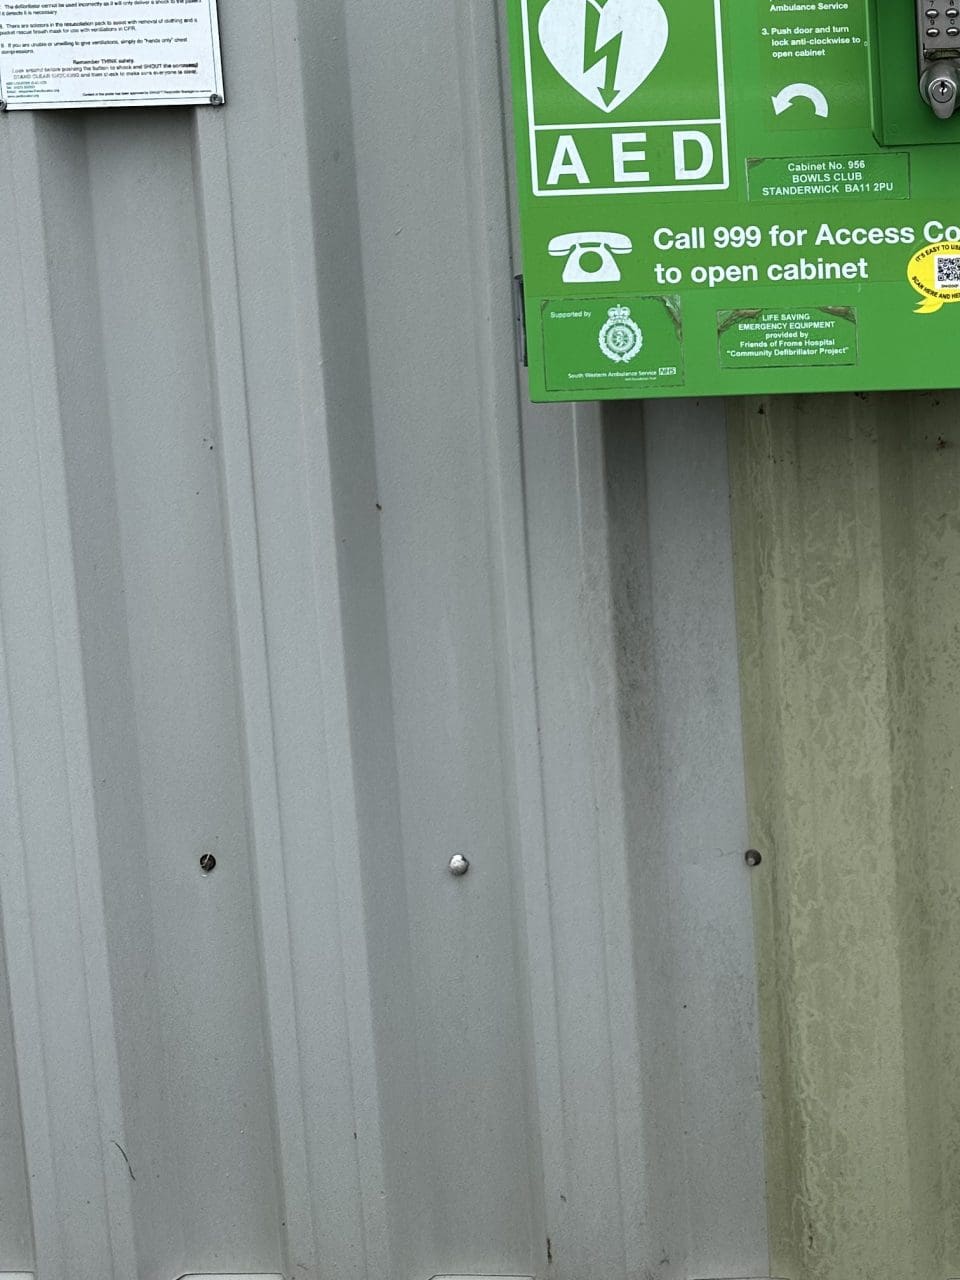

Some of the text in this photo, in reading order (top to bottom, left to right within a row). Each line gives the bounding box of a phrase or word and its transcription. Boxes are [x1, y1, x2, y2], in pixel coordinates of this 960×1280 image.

[770, 1, 849, 12] Ambulance Service
[761, 28, 770, 36] 3.
[771, 27, 792, 36] Push
[793, 26, 813, 35] door
[815, 25, 831, 34] and
[771, 36, 861, 47] lock anti-clockwise to
[772, 49, 826, 59] open cabinet
[787, 160, 866, 172] Cabinet No. 956
[792, 172, 862, 184] BOWLS CLUB
[762, 182, 894, 196] STANDERWICK BA11 2PU
[653, 226, 705, 250] Call
[713, 225, 762, 248] 999
[768, 224, 808, 247] for
[814, 223, 915, 246] Access
[915, 253, 926, 263] IT'S
[925, 246, 940, 256] EASY
[654, 257, 869, 288] to open cabinet
[912, 275, 924, 289] SCAN
[923, 287, 938, 298] HERE
[938, 292, 951, 300] AND
[550, 311, 582, 319] Supported
[781, 313, 811, 321] SAVING
[738, 321, 836, 331] EMERGENCY EQUIPMENT
[765, 331, 809, 340] provided by
[740, 341, 768, 349] Friends
[779, 339, 803, 348] Frome
[804, 338, 835, 348] Hospital
[727, 346, 849, 358] "Community Defibrillator Project"
[659, 367, 676, 375] NHS
